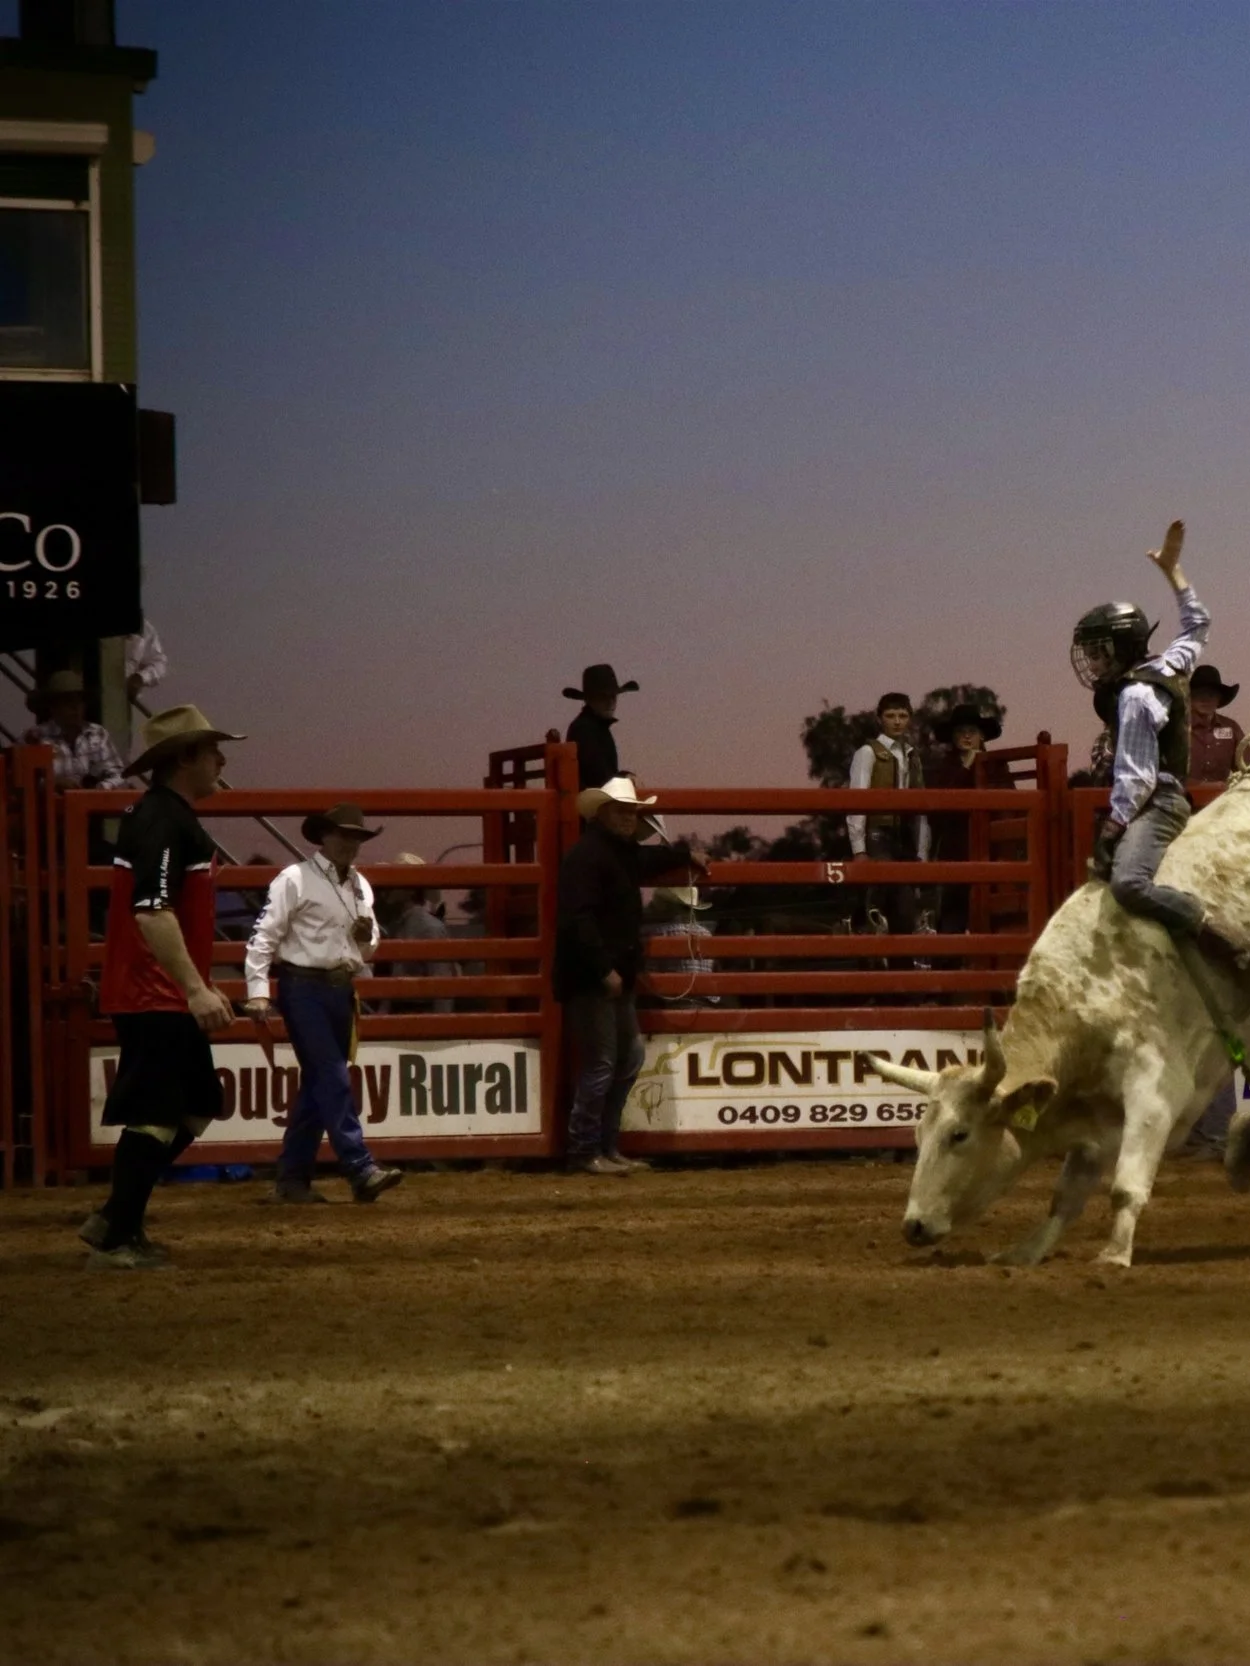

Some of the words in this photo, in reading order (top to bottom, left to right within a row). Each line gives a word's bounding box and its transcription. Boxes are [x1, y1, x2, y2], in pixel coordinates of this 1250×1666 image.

[5, 580, 82, 600] 1926
[826, 861, 845, 884] 5
[399, 1052, 528, 1117] Rural
[718, 1104, 801, 1125] 0409
[808, 1103, 868, 1123] 829
